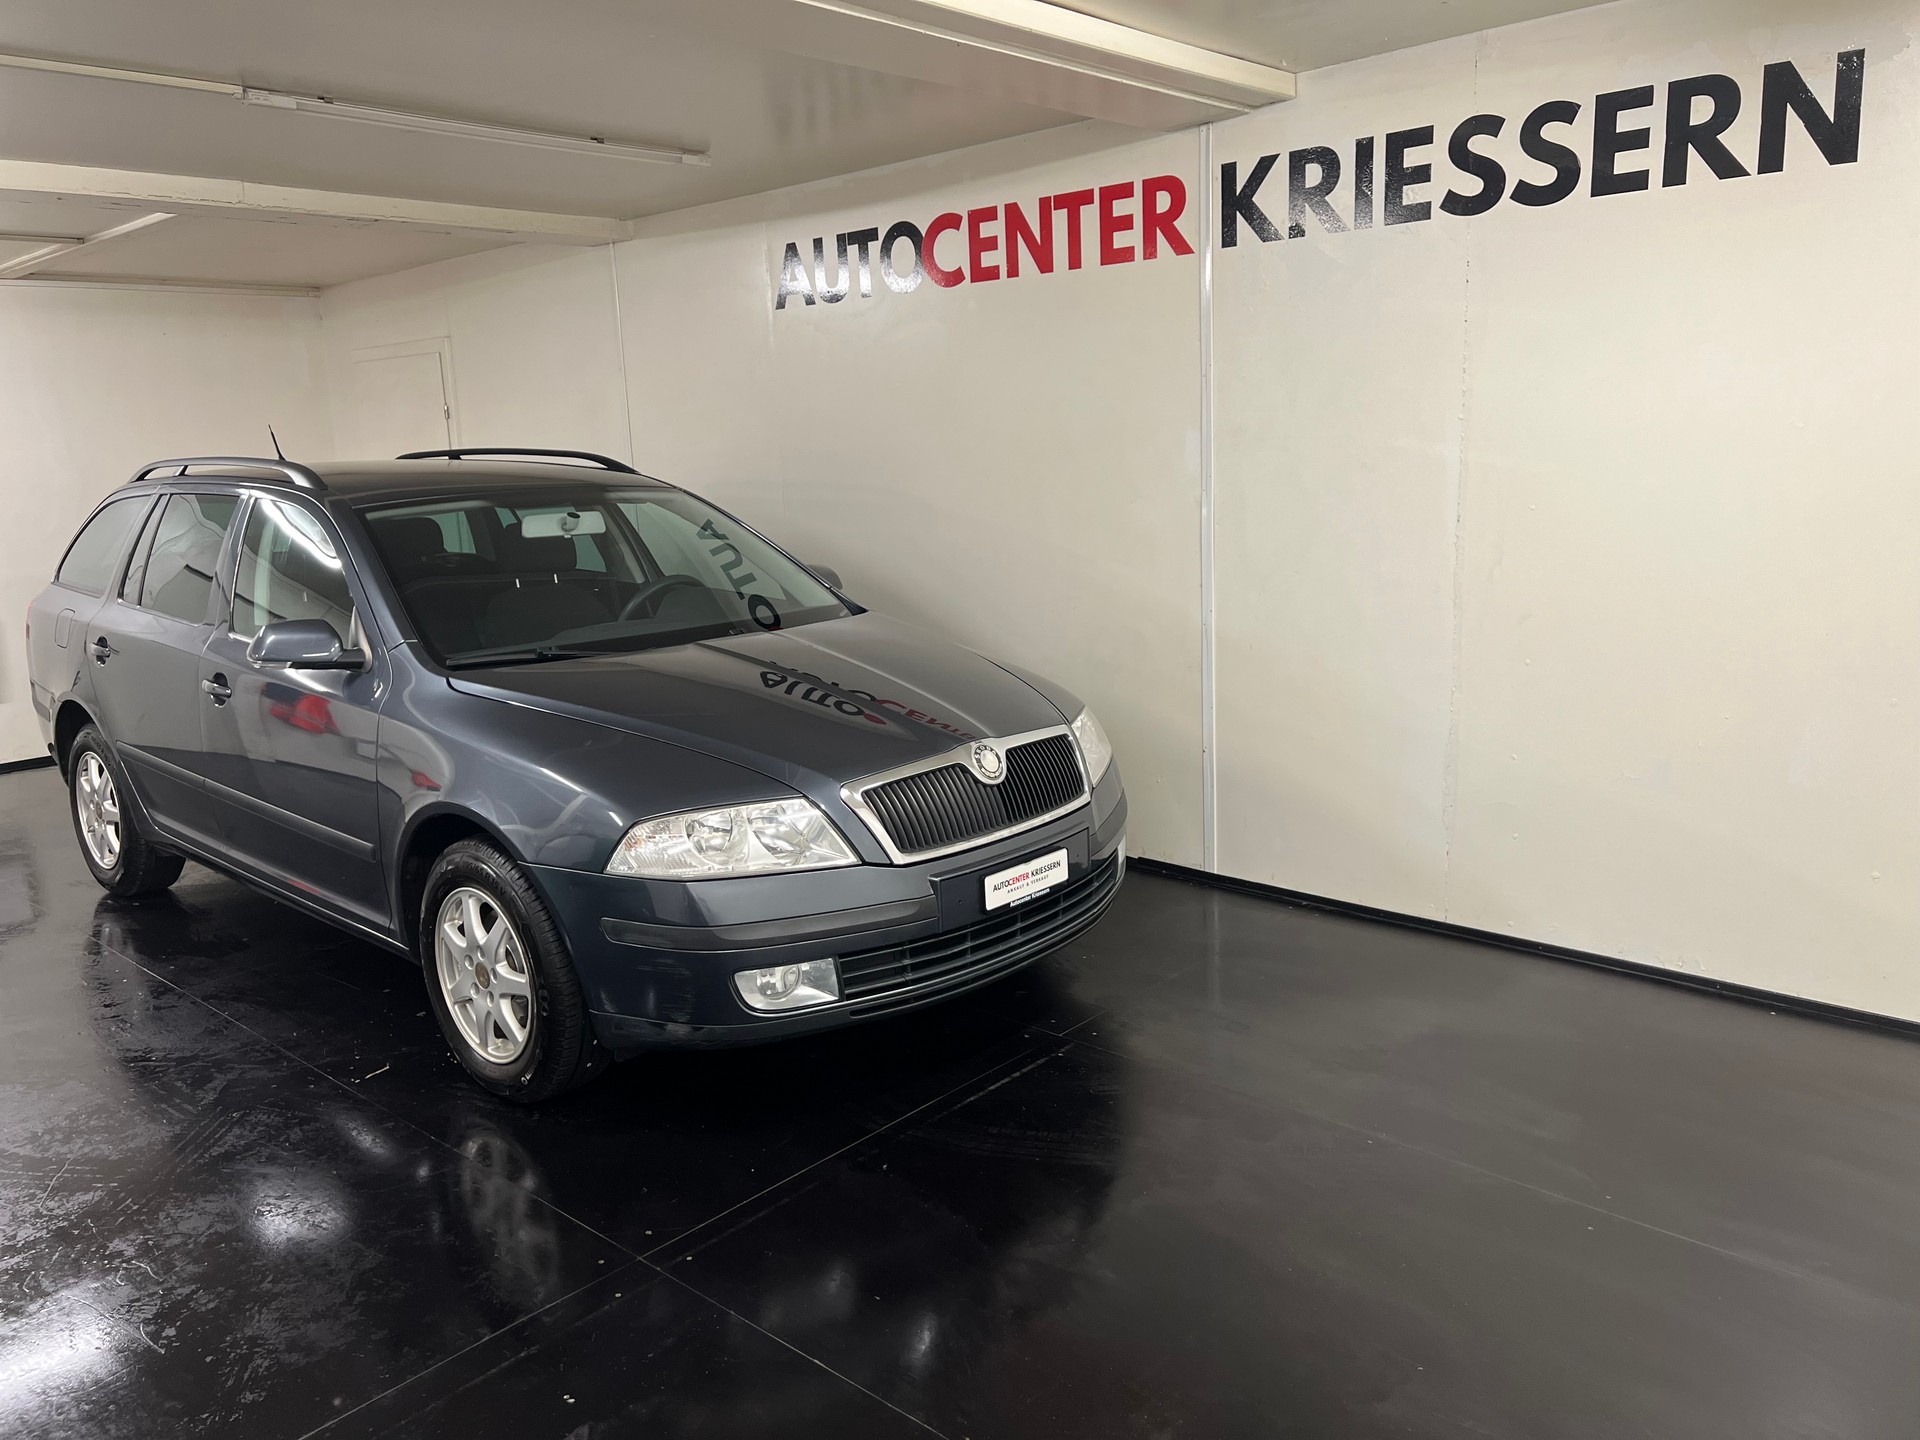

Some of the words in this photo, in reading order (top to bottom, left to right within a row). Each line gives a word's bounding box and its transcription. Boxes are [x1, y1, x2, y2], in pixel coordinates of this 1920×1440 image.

[775, 175, 1195, 310] AUTOCENTER
[1220, 47, 1866, 248] KRIESSERN
[993, 872, 1030, 892] AUTOCENTER
[1031, 860, 1061, 877] KRIESSERN
